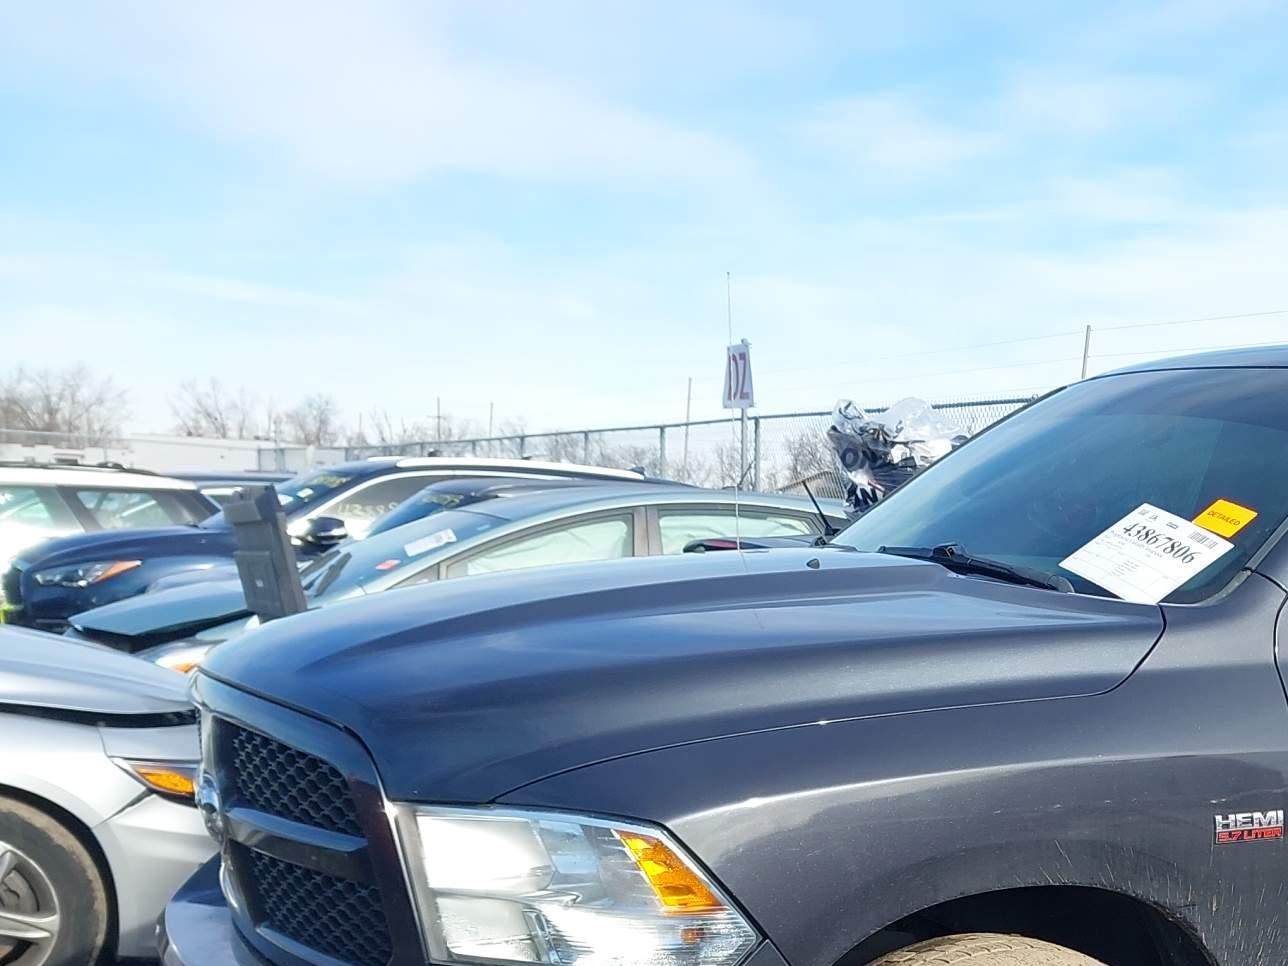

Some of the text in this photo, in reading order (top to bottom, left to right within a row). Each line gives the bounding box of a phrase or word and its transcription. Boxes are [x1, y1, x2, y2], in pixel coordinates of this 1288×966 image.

[1206, 509, 1241, 527] DETAILED
[1123, 522, 1202, 564] 43867806
[1214, 809, 1284, 831] HEMI
[1217, 827, 1282, 842] 5.7 LITER
